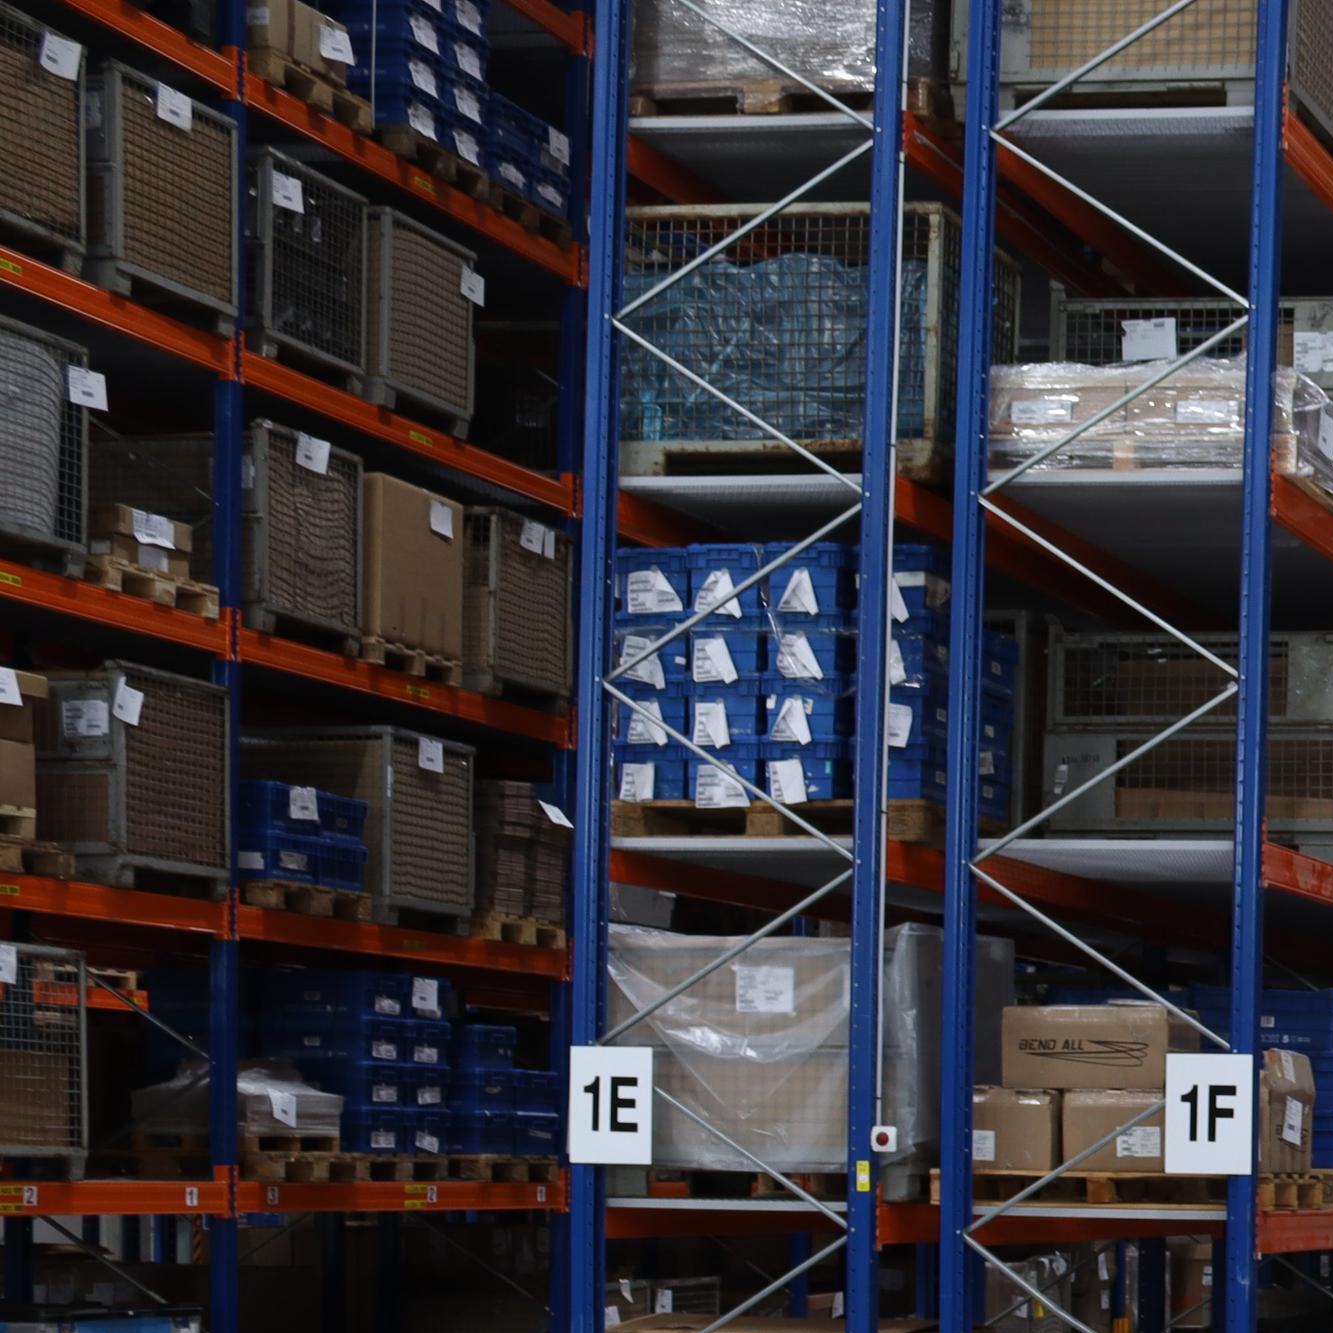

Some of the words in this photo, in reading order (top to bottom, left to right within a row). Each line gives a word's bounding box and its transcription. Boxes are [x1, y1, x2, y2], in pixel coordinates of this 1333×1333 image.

[1018, 1038, 1057, 1051] BEND
[1061, 1038, 1084, 1051] ALL
[584, 1076, 639, 1132] 1E
[1181, 1084, 1237, 1142] 1F
